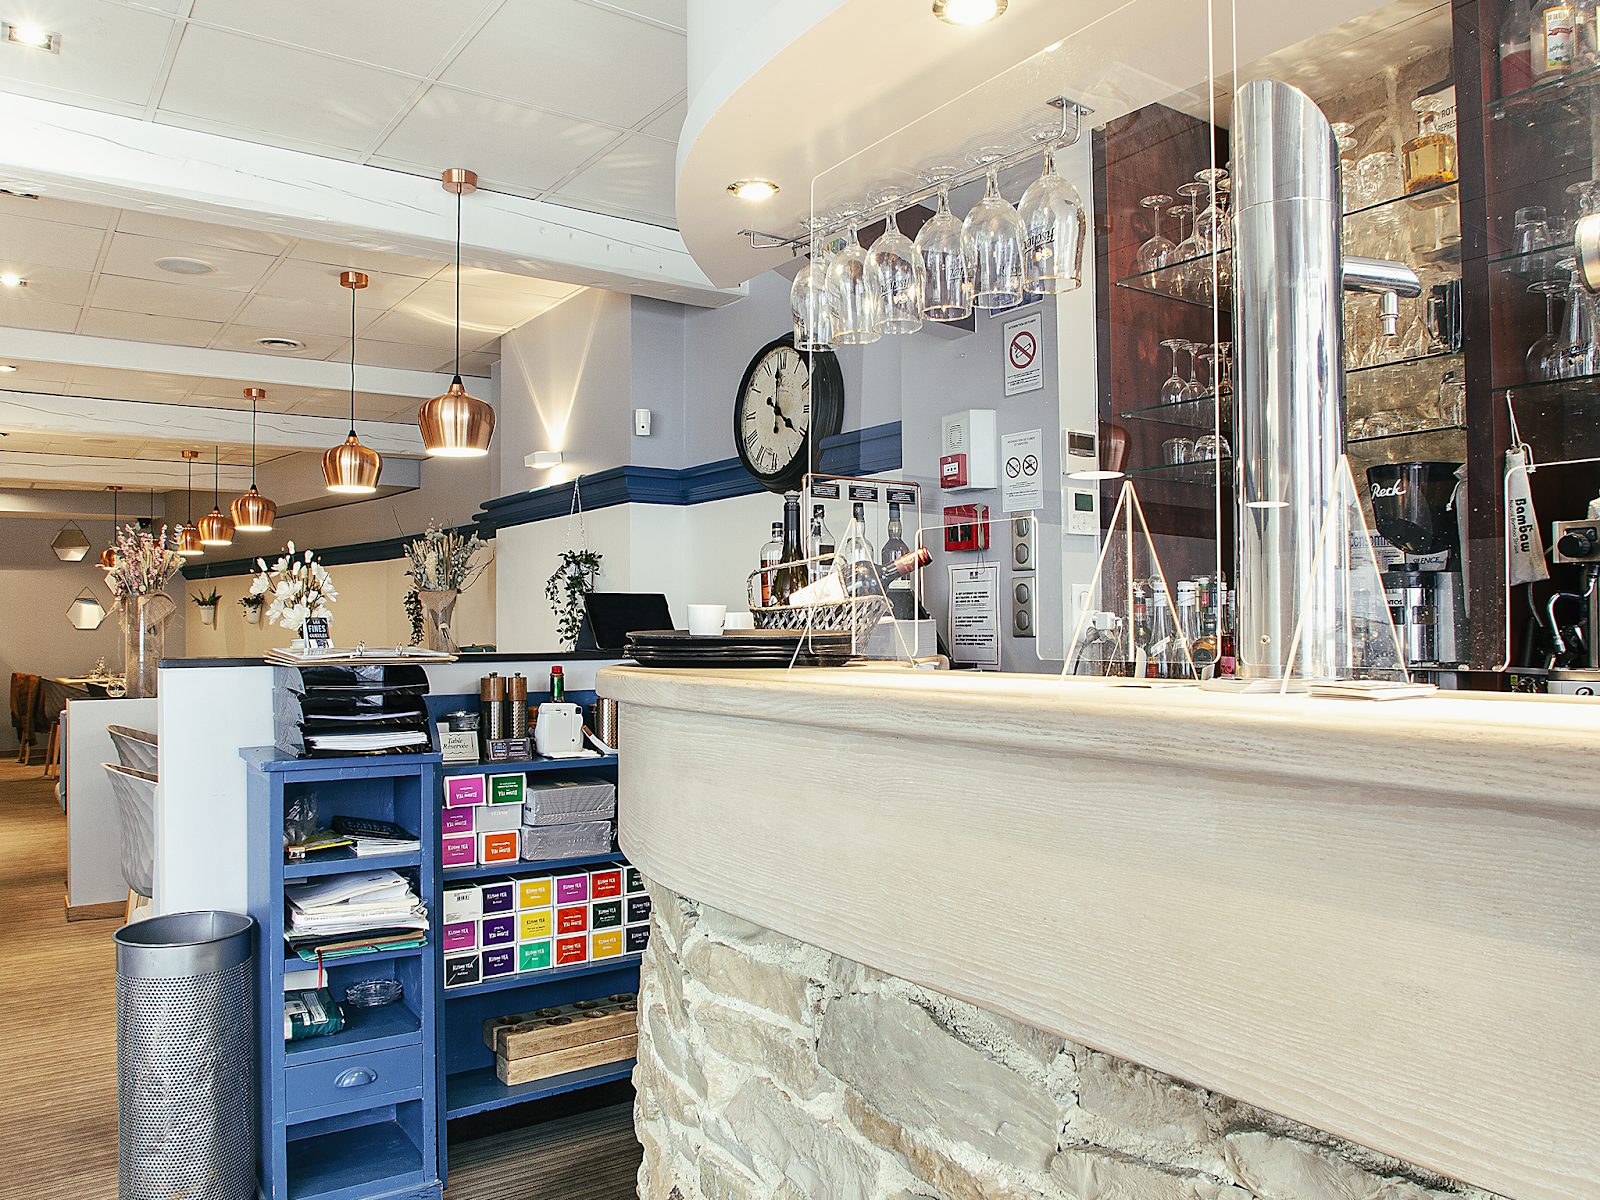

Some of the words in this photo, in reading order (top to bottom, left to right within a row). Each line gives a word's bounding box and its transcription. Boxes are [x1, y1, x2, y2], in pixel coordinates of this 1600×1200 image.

[1024, 227, 1055, 254] Fischer
[1371, 479, 1406, 500] Reck
[1515, 498, 1534, 553] Bambaw
[1412, 556, 1441, 565] SILENCE
[308, 624, 327, 633] FINES
